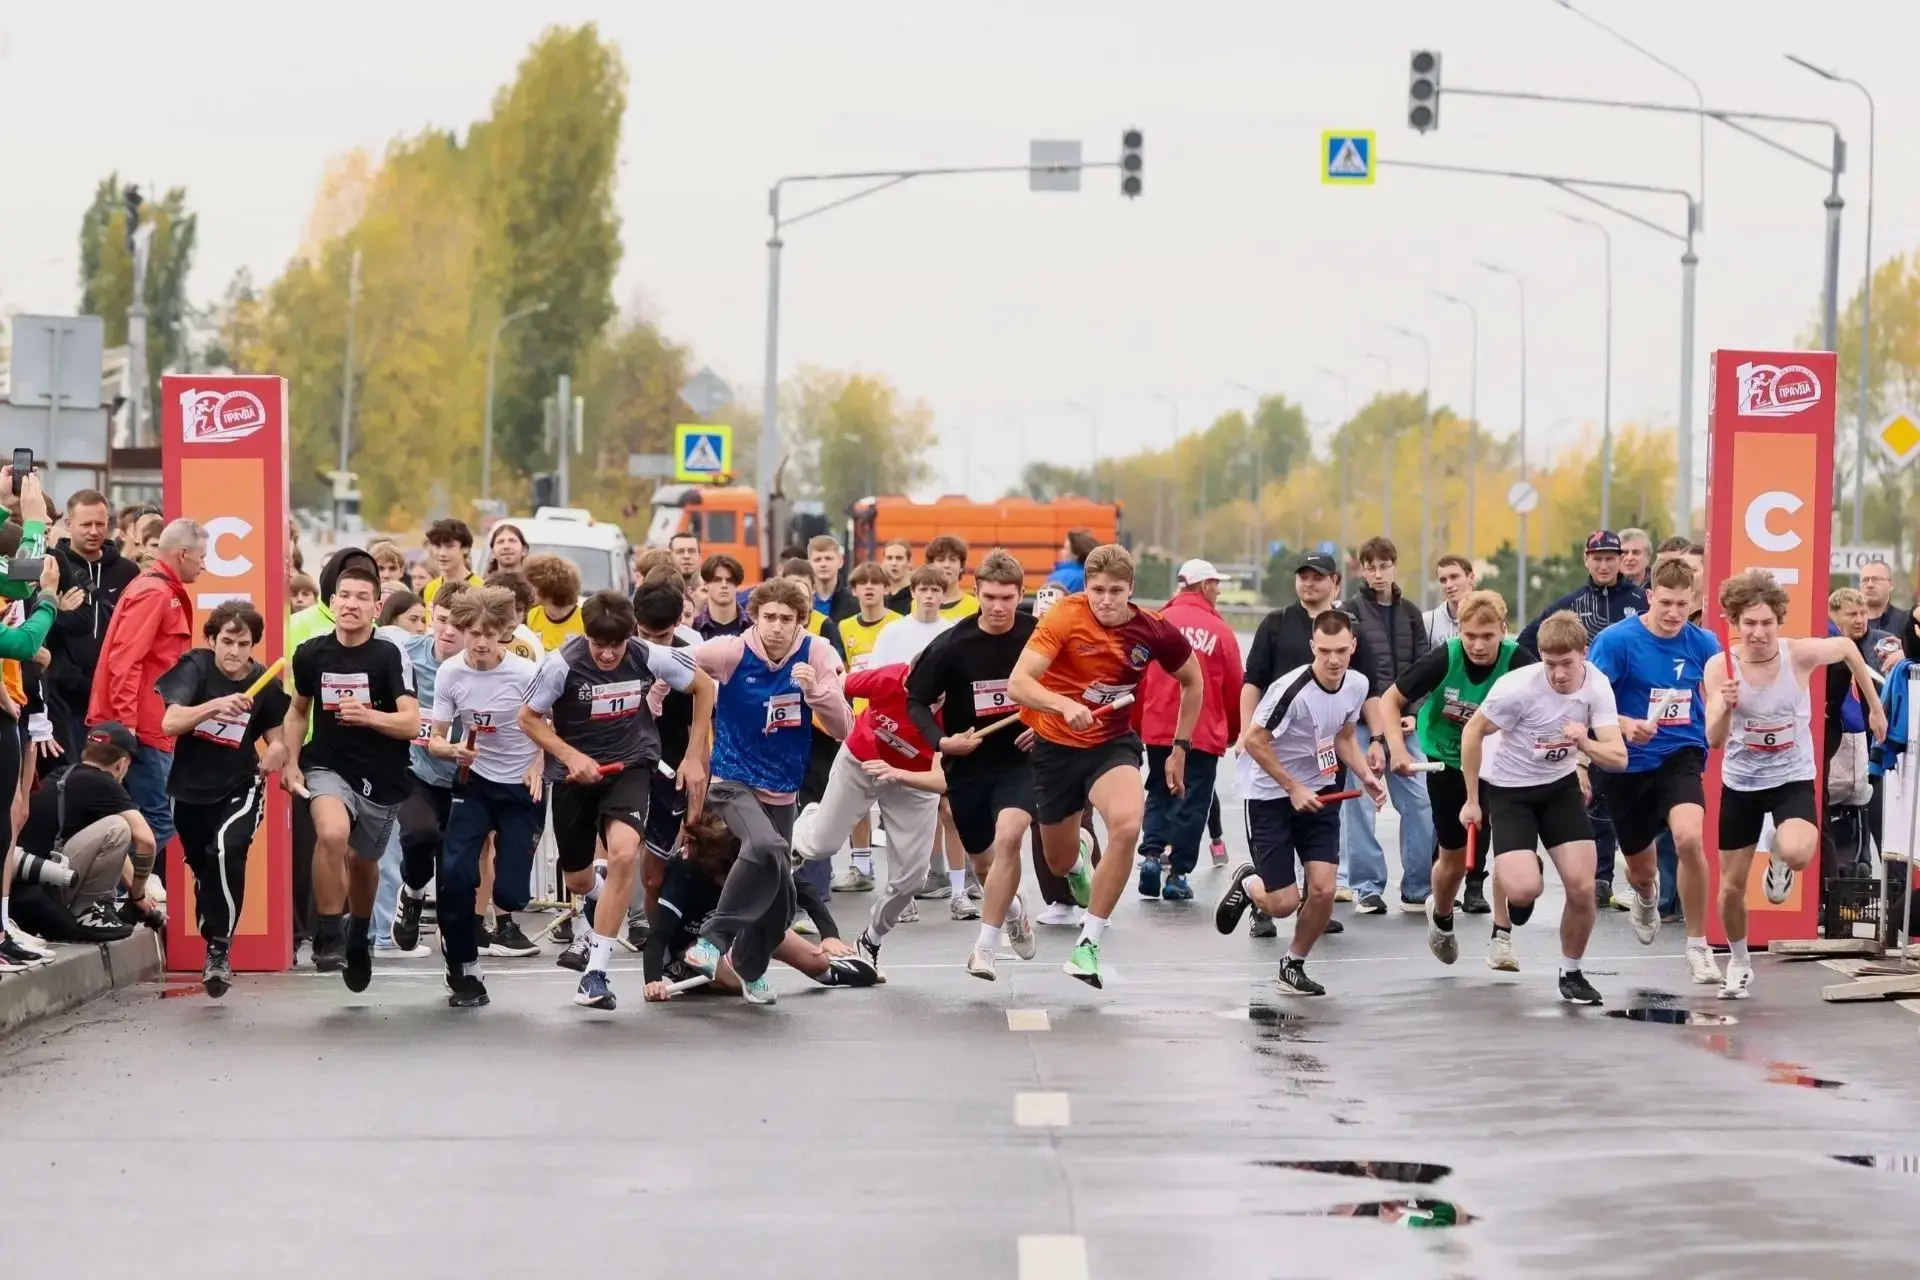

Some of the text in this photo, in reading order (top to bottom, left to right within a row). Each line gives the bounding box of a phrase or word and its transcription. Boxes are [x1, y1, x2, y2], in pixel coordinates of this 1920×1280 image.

[609, 698, 625, 712] 11
[993, 693, 1005, 706] 9
[1664, 704, 1679, 718] 13
[473, 713, 492, 726] 57
[215, 722, 228, 736] 7
[1763, 733, 1776, 746] 6
[1320, 750, 1335, 768] 118
